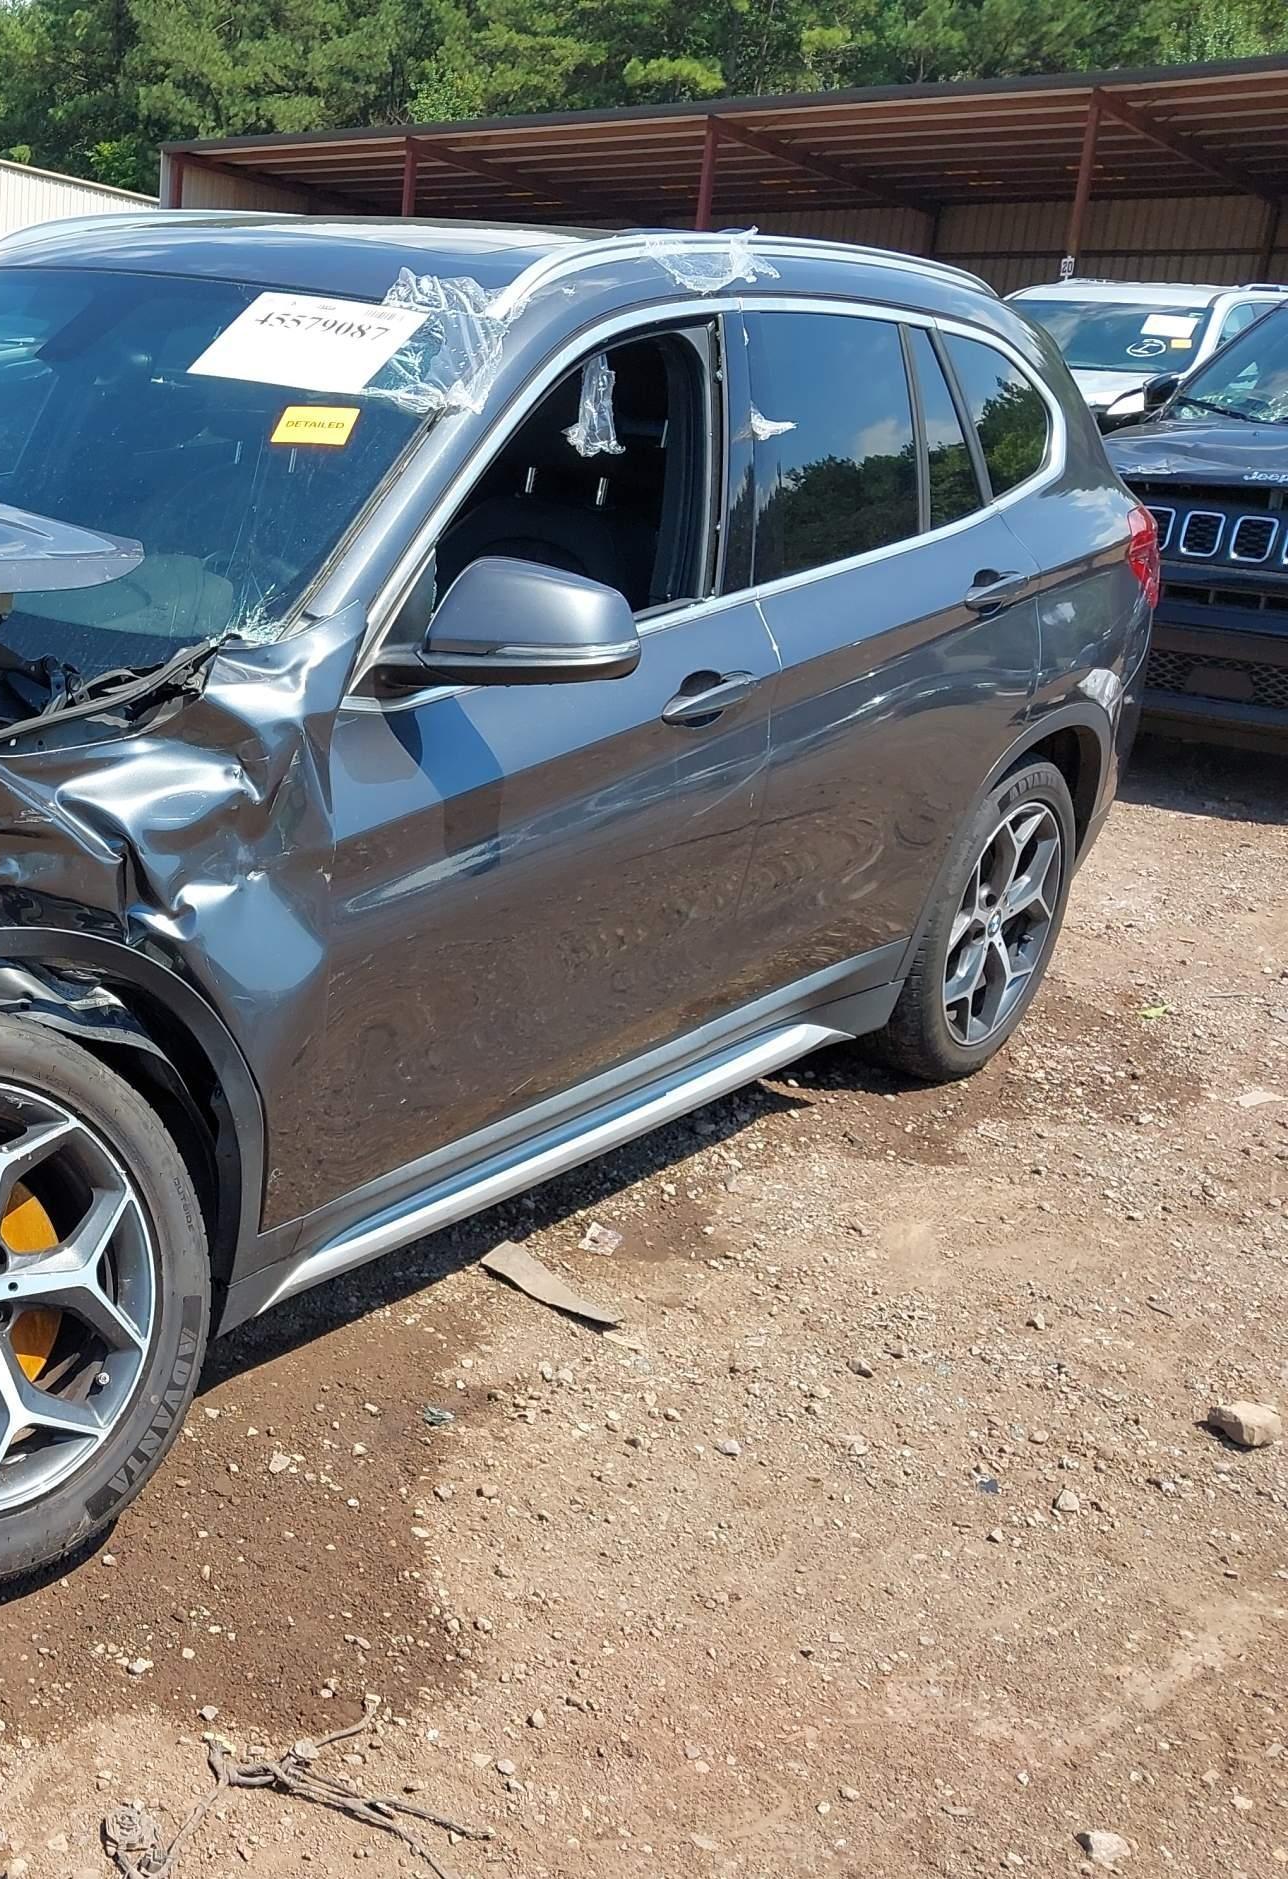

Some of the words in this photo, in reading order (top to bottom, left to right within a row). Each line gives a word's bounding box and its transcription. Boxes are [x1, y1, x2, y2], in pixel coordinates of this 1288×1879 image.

[1062, 260, 1073, 274] 20
[255, 311, 391, 341] 45579087
[285, 420, 345, 429] DETAILED
[172, 1175, 196, 1232] OUTSIDE
[107, 1327, 199, 1495] ADVANTA
